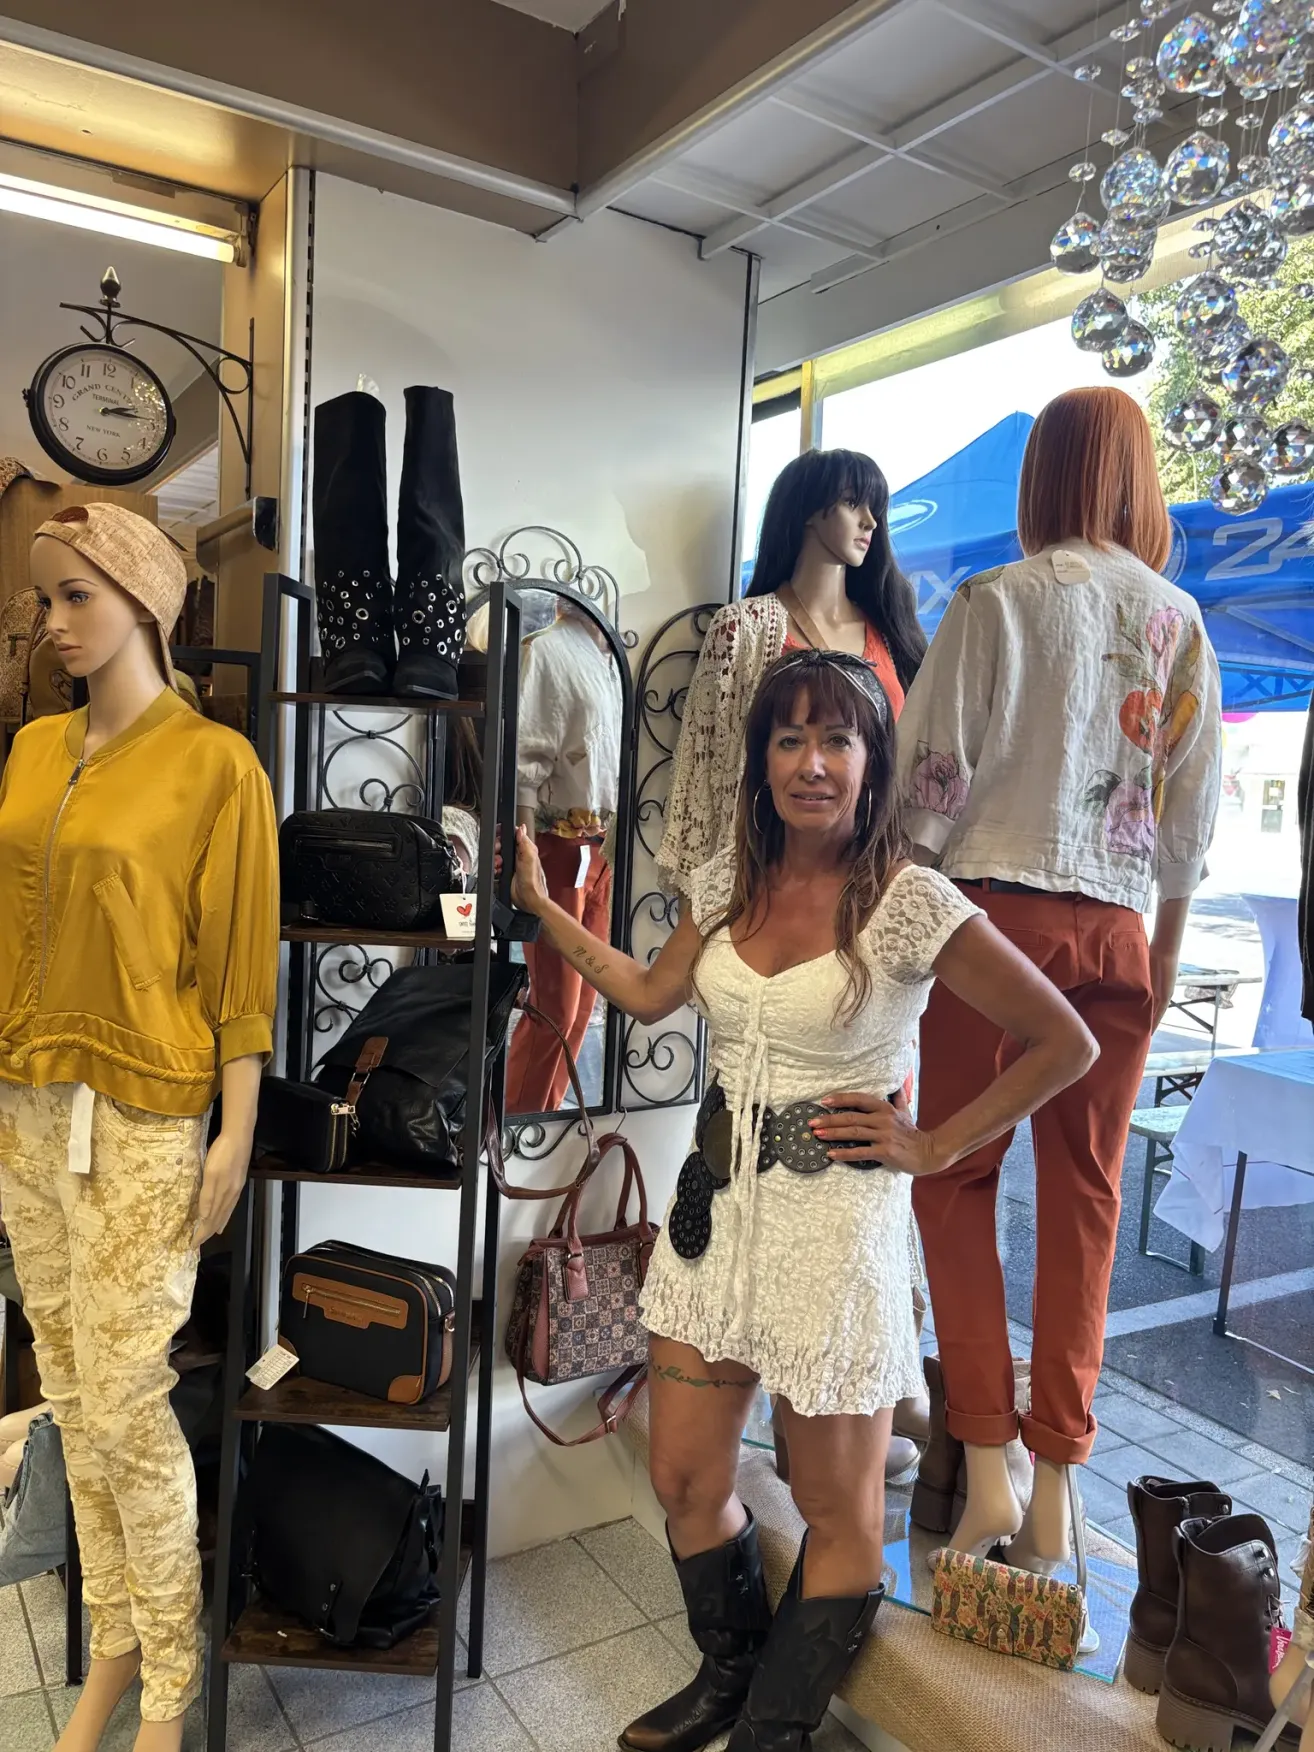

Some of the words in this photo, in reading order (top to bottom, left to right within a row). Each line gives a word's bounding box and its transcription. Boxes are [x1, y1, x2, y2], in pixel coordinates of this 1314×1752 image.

[80, 363, 91, 378] 11
[102, 363, 116, 378] 12
[61, 375, 76, 390] 10
[72, 384, 101, 401] GRAND
[92, 393, 120, 406] TERMINAL
[53, 394, 65, 409] 9
[58, 417, 69, 432] 8
[86, 424, 101, 433] NEW
[103, 429, 121, 438] YORK
[75, 436, 84, 450] 7
[97, 448, 108, 462] 6
[121, 447, 131, 461] 5
